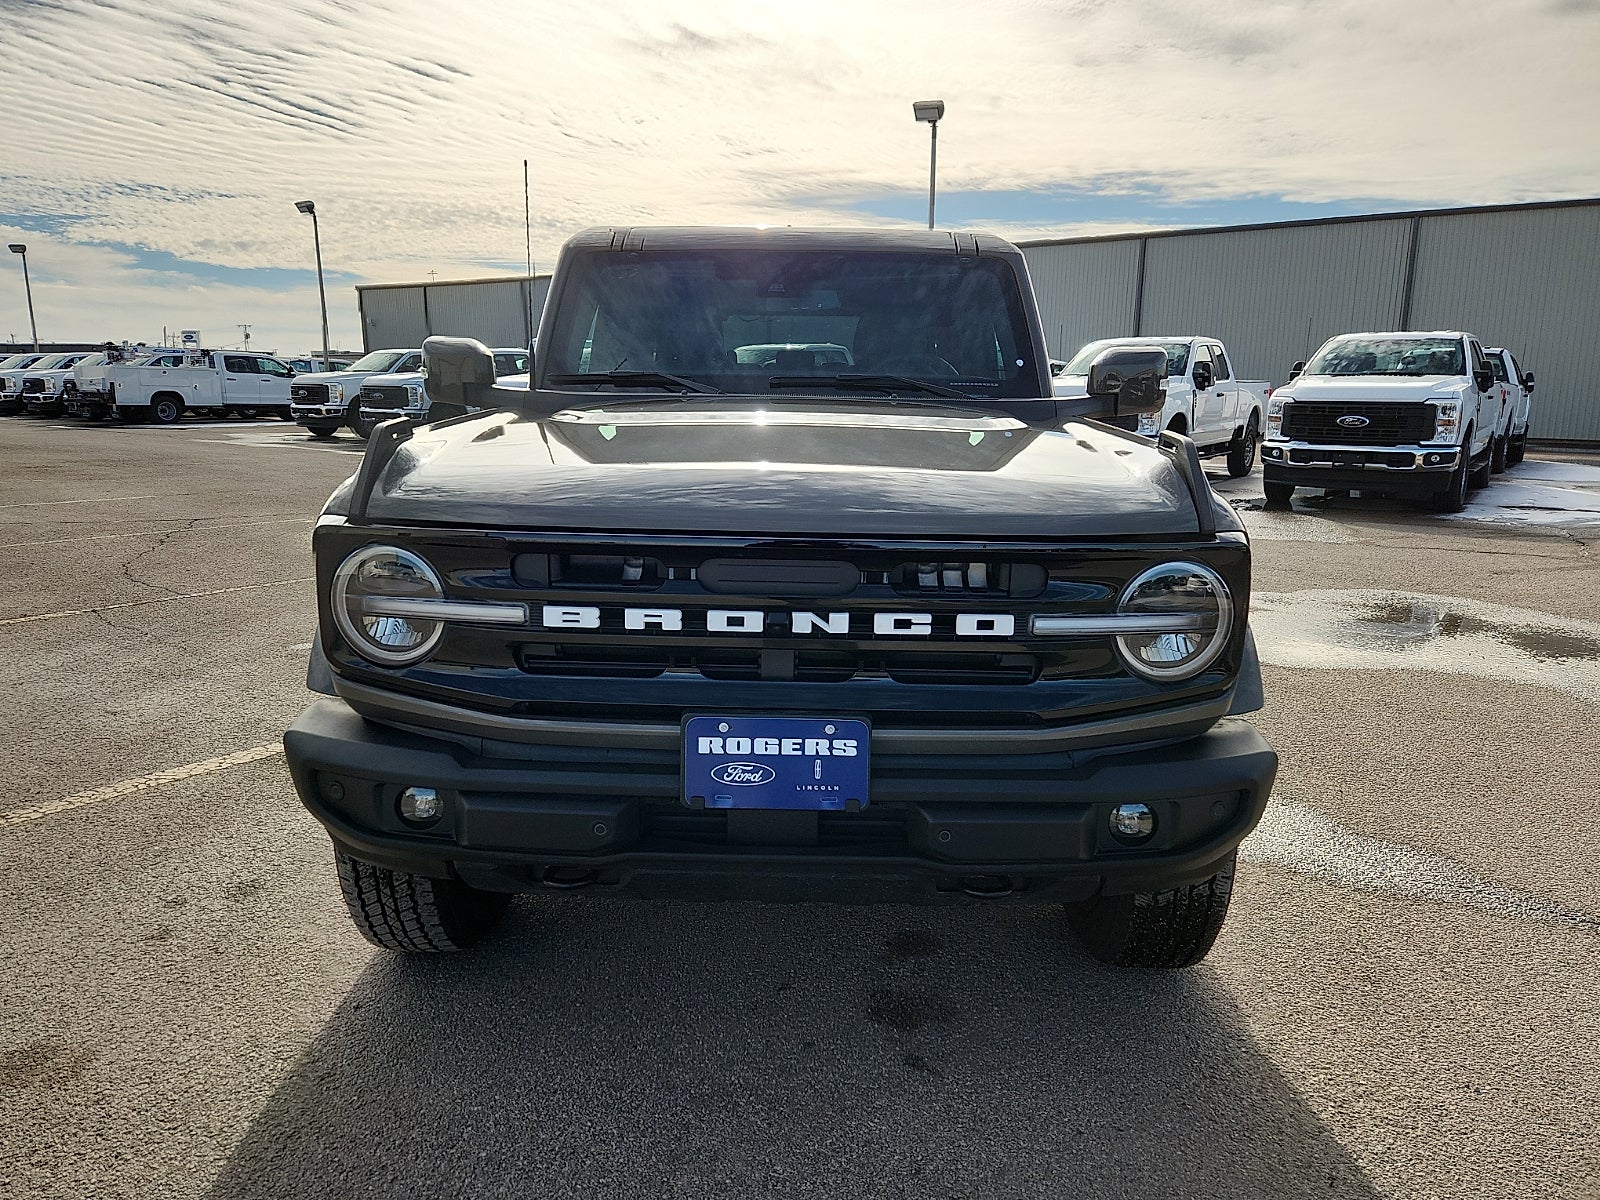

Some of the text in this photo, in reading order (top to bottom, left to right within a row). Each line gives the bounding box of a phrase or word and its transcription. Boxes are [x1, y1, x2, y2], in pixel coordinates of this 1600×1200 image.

[542, 605, 1015, 636] BRONCO
[697, 736, 858, 757] ROGERS
[723, 765, 763, 782] Ford
